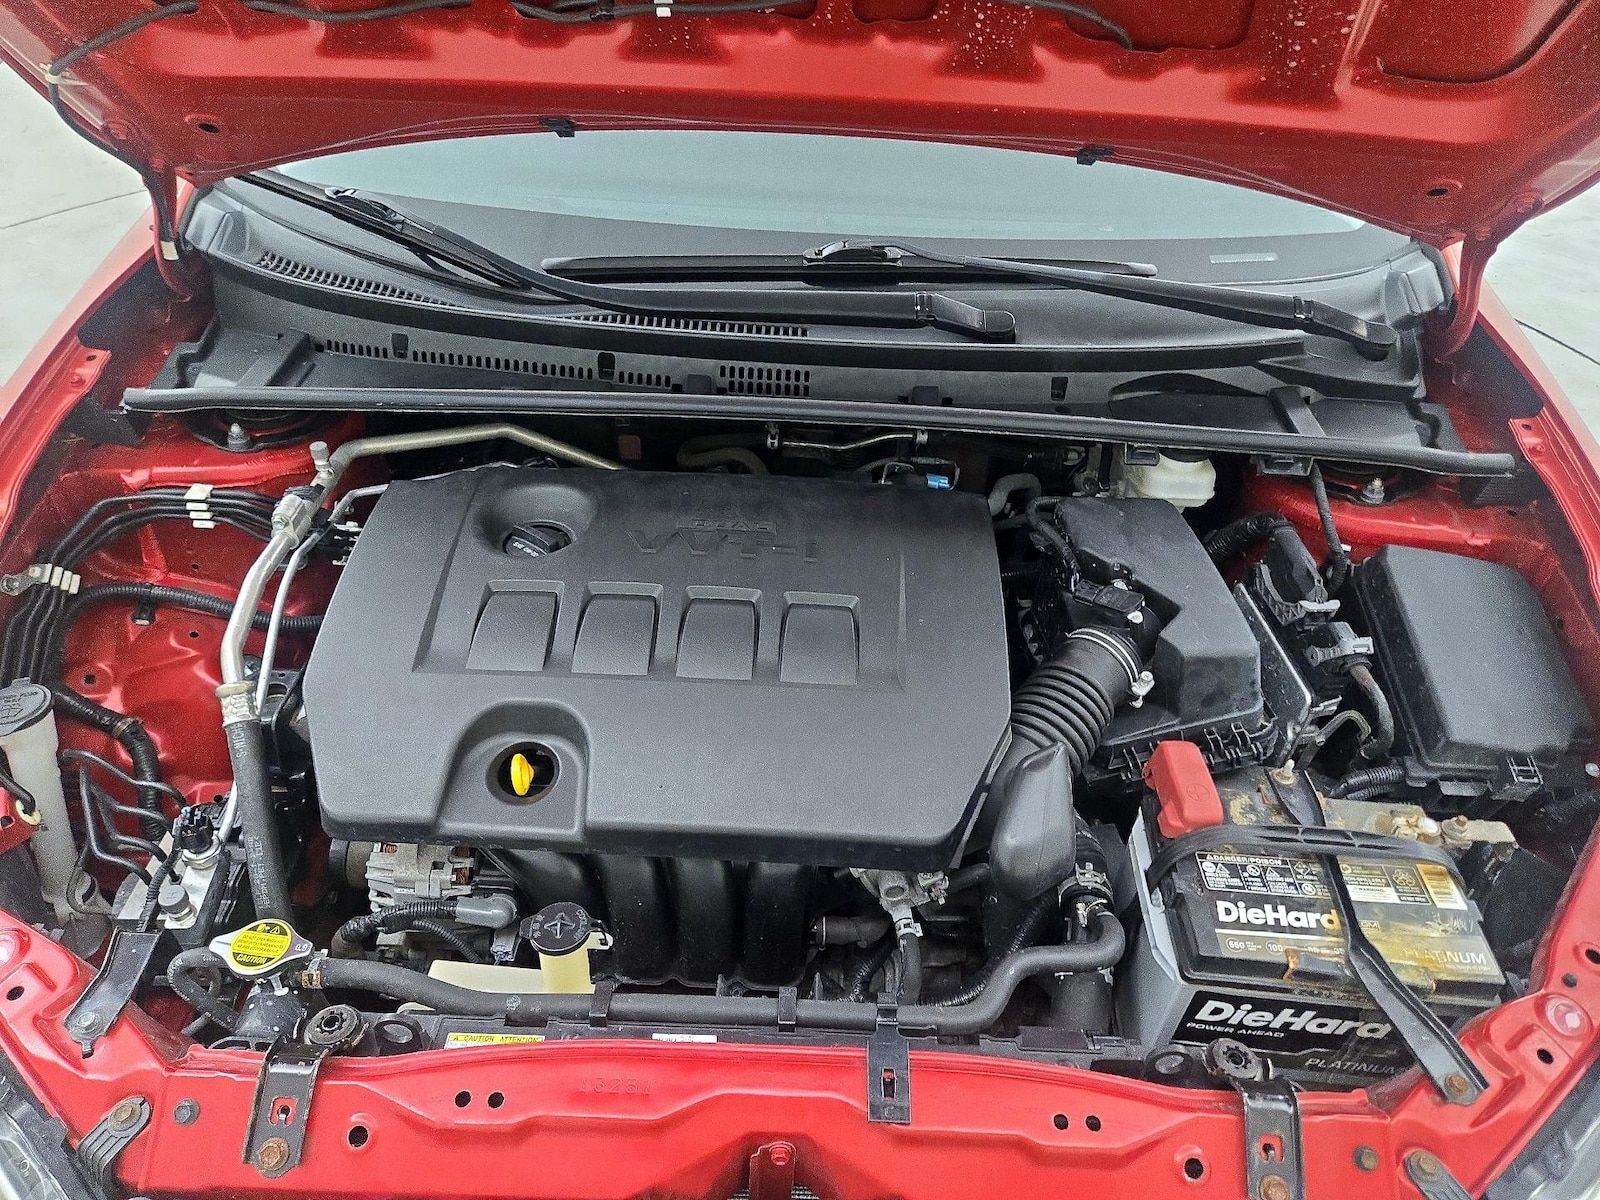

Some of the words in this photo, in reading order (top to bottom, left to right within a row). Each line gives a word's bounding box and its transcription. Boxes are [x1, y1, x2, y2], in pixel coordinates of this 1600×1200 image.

[1215, 900, 1342, 930] DieHard
[236, 953, 268, 965] CAUTION
[1194, 1000, 1392, 1039] DieHard
[463, 1034, 495, 1042] CAUTION
[1186, 1022, 1235, 1033] POWER
[1236, 1029, 1285, 1038] AHEAD
